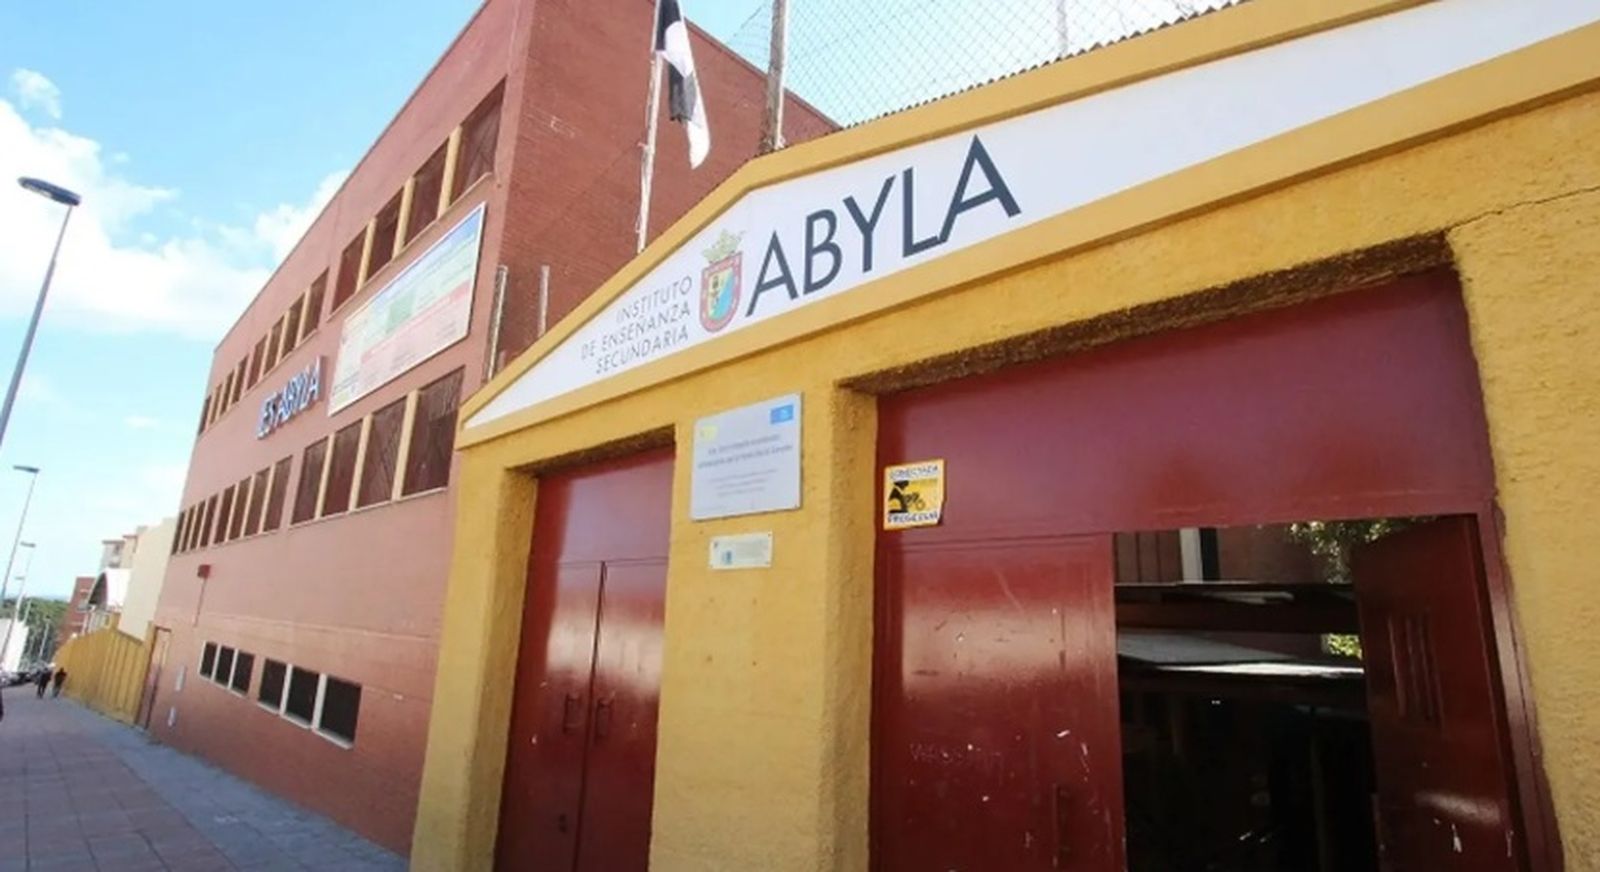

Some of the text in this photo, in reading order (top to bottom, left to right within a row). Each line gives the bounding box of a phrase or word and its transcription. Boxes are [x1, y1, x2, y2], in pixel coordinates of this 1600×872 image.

[746, 134, 1021, 317] ABYLA
[616, 275, 693, 323] INSTITUTO
[580, 301, 690, 360] DE ENSEÑANZA
[595, 325, 689, 374] SECUNDARIA
